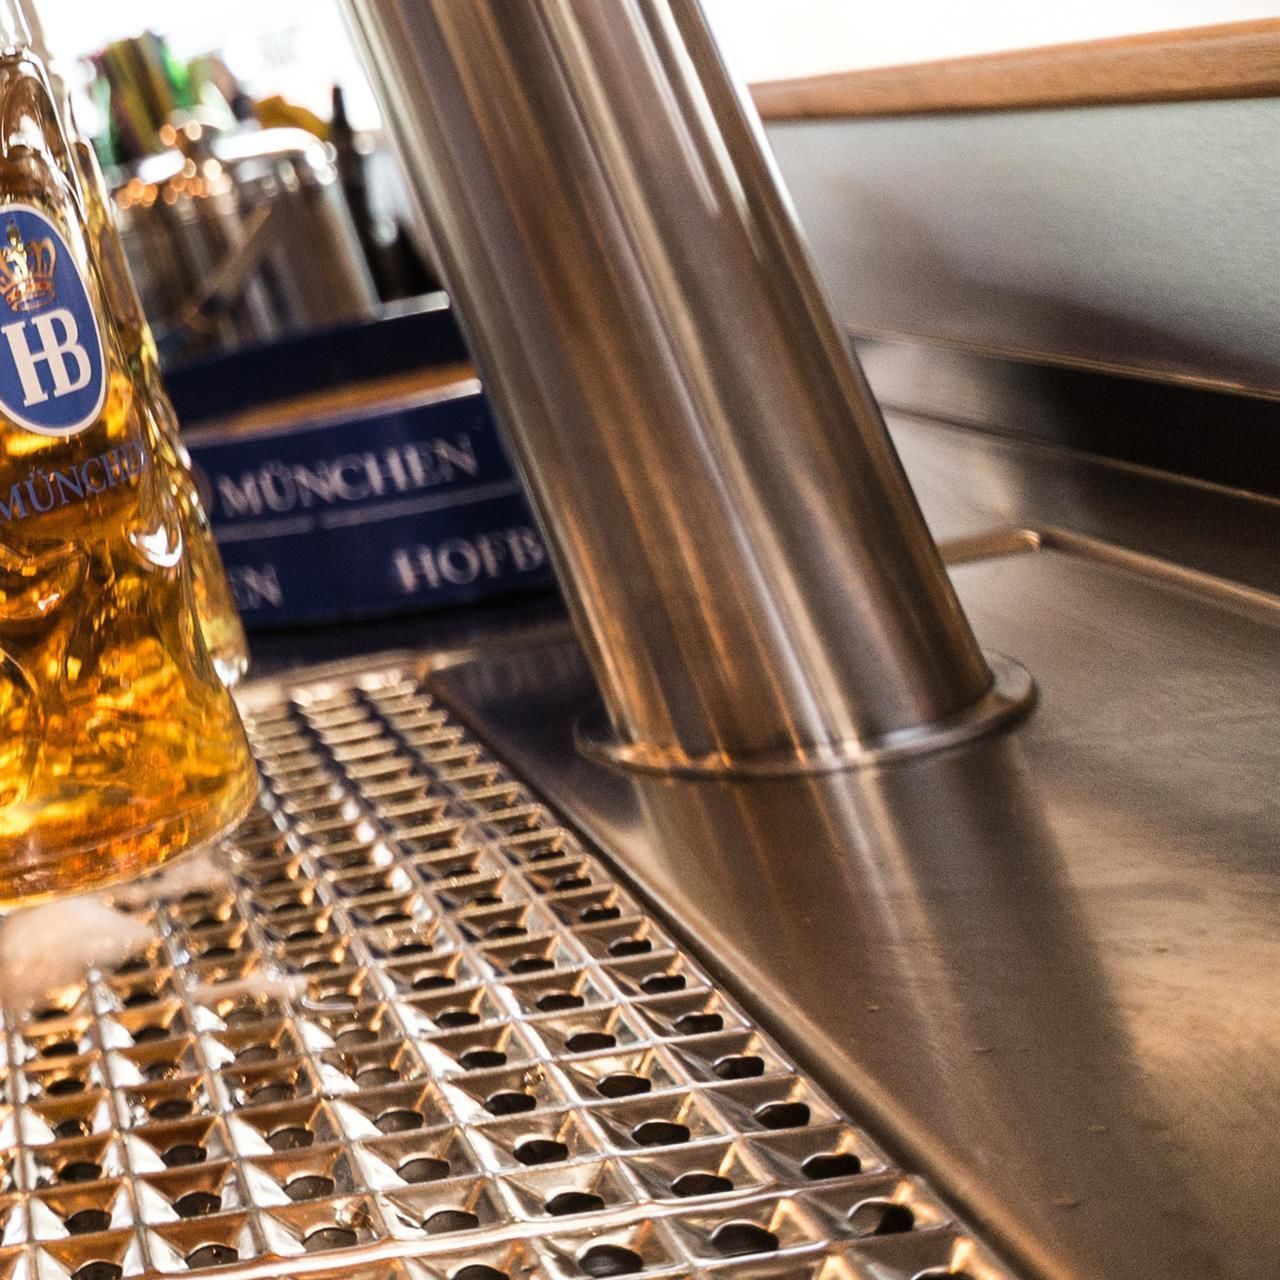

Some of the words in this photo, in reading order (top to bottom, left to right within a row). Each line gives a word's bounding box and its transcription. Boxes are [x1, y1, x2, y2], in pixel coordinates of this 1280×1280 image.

[0, 308, 91, 407] HB
[217, 432, 479, 518] MÜNCHEN
[393, 525, 546, 593] HOFB
